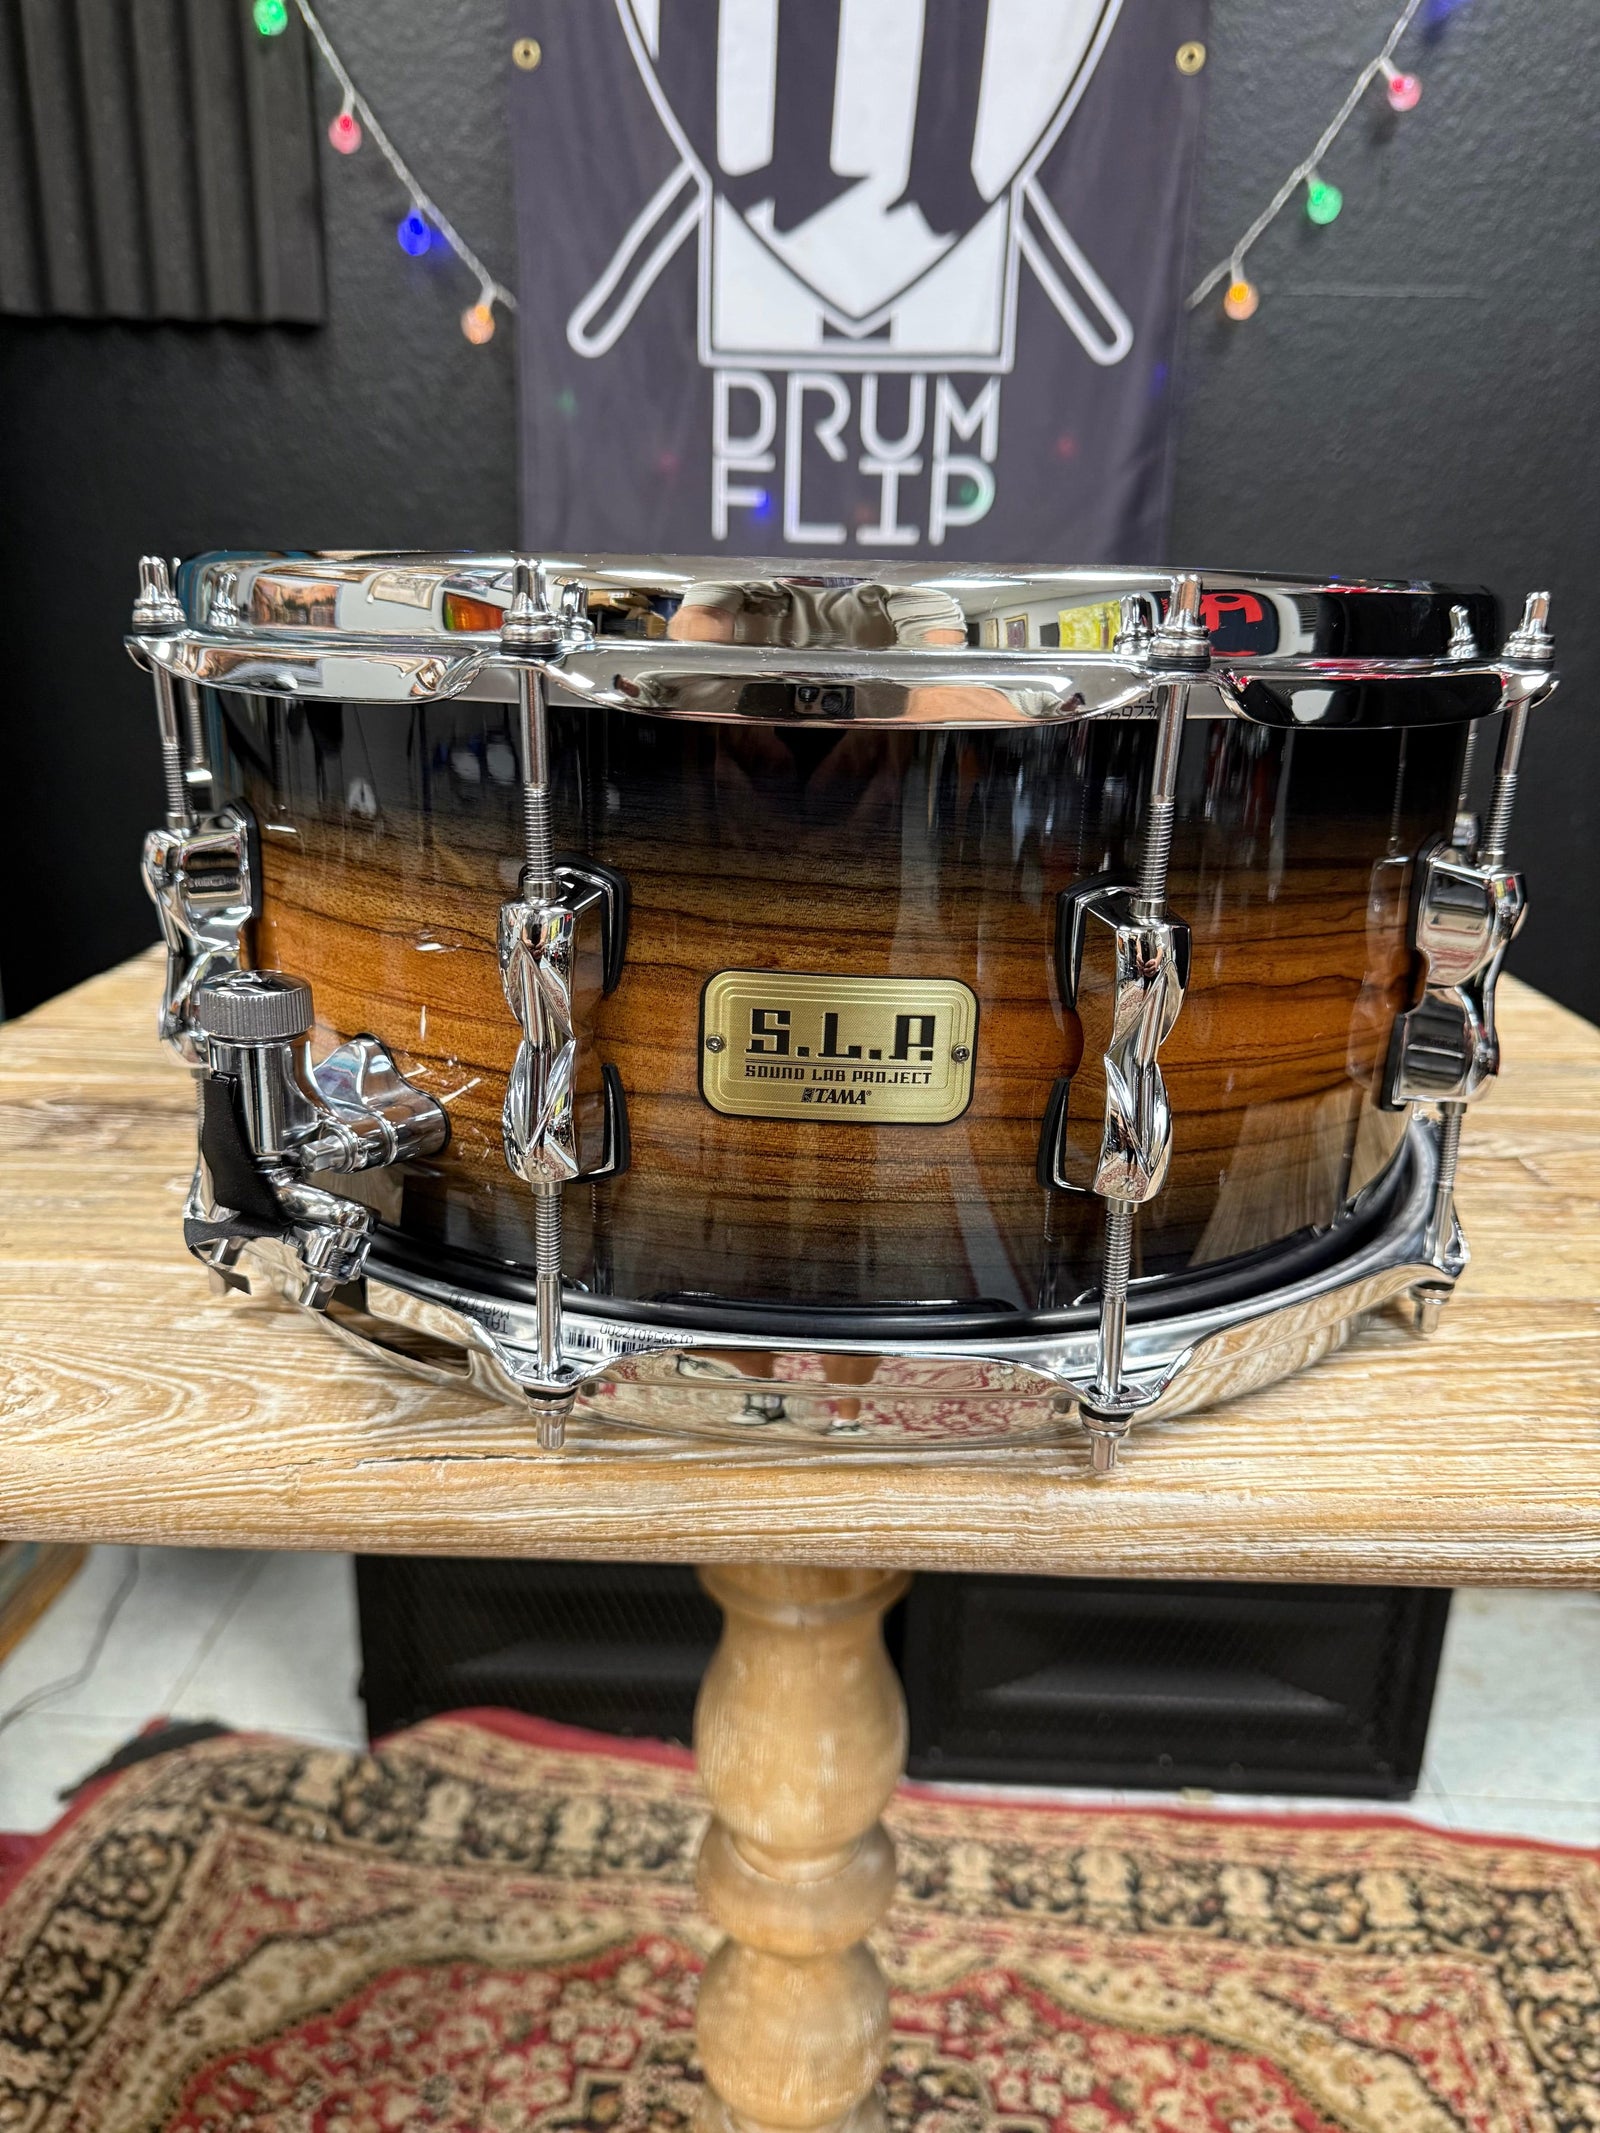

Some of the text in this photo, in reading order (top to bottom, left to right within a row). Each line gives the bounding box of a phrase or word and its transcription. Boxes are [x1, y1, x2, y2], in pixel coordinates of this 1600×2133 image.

[712, 372, 1001, 461] DRUM
[712, 454, 996, 546] FLIP
[745, 1065, 932, 1085] SOUND LAB PROJECT
